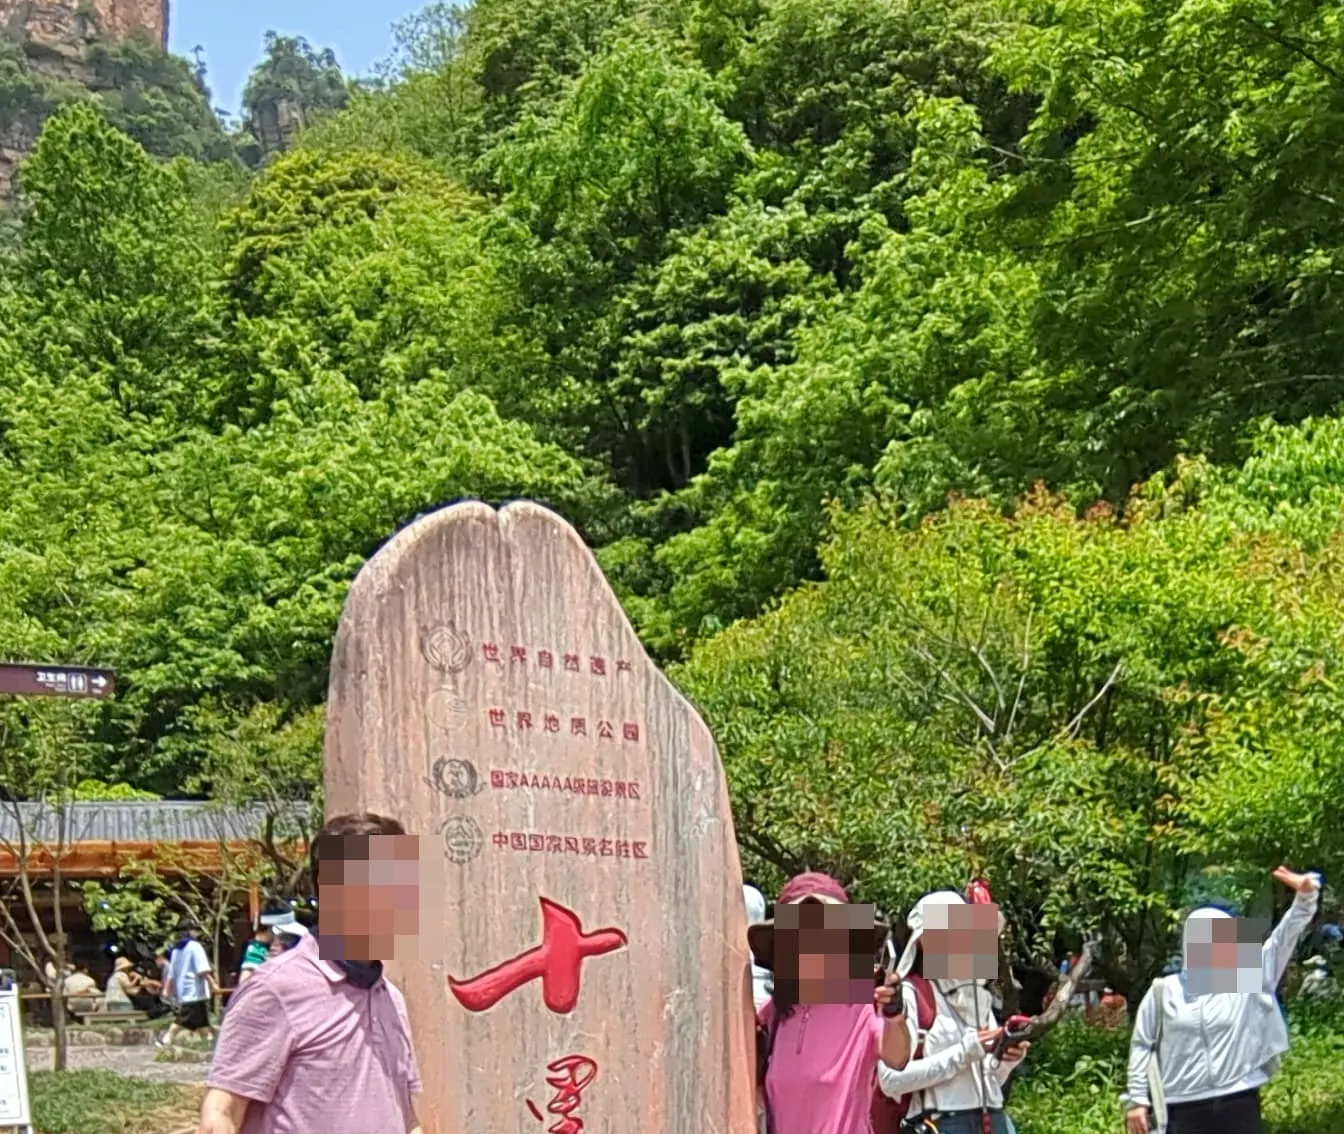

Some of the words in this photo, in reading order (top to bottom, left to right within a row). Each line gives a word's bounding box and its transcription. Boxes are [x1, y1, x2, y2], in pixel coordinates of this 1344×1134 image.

[483, 642, 632, 675] 世界自然遗产
[489, 708, 640, 741] 世界地质公园
[490, 769, 641, 799] 国家AAAAA级旅游景区
[492, 831, 648, 858] 中国国家风景名胜区
